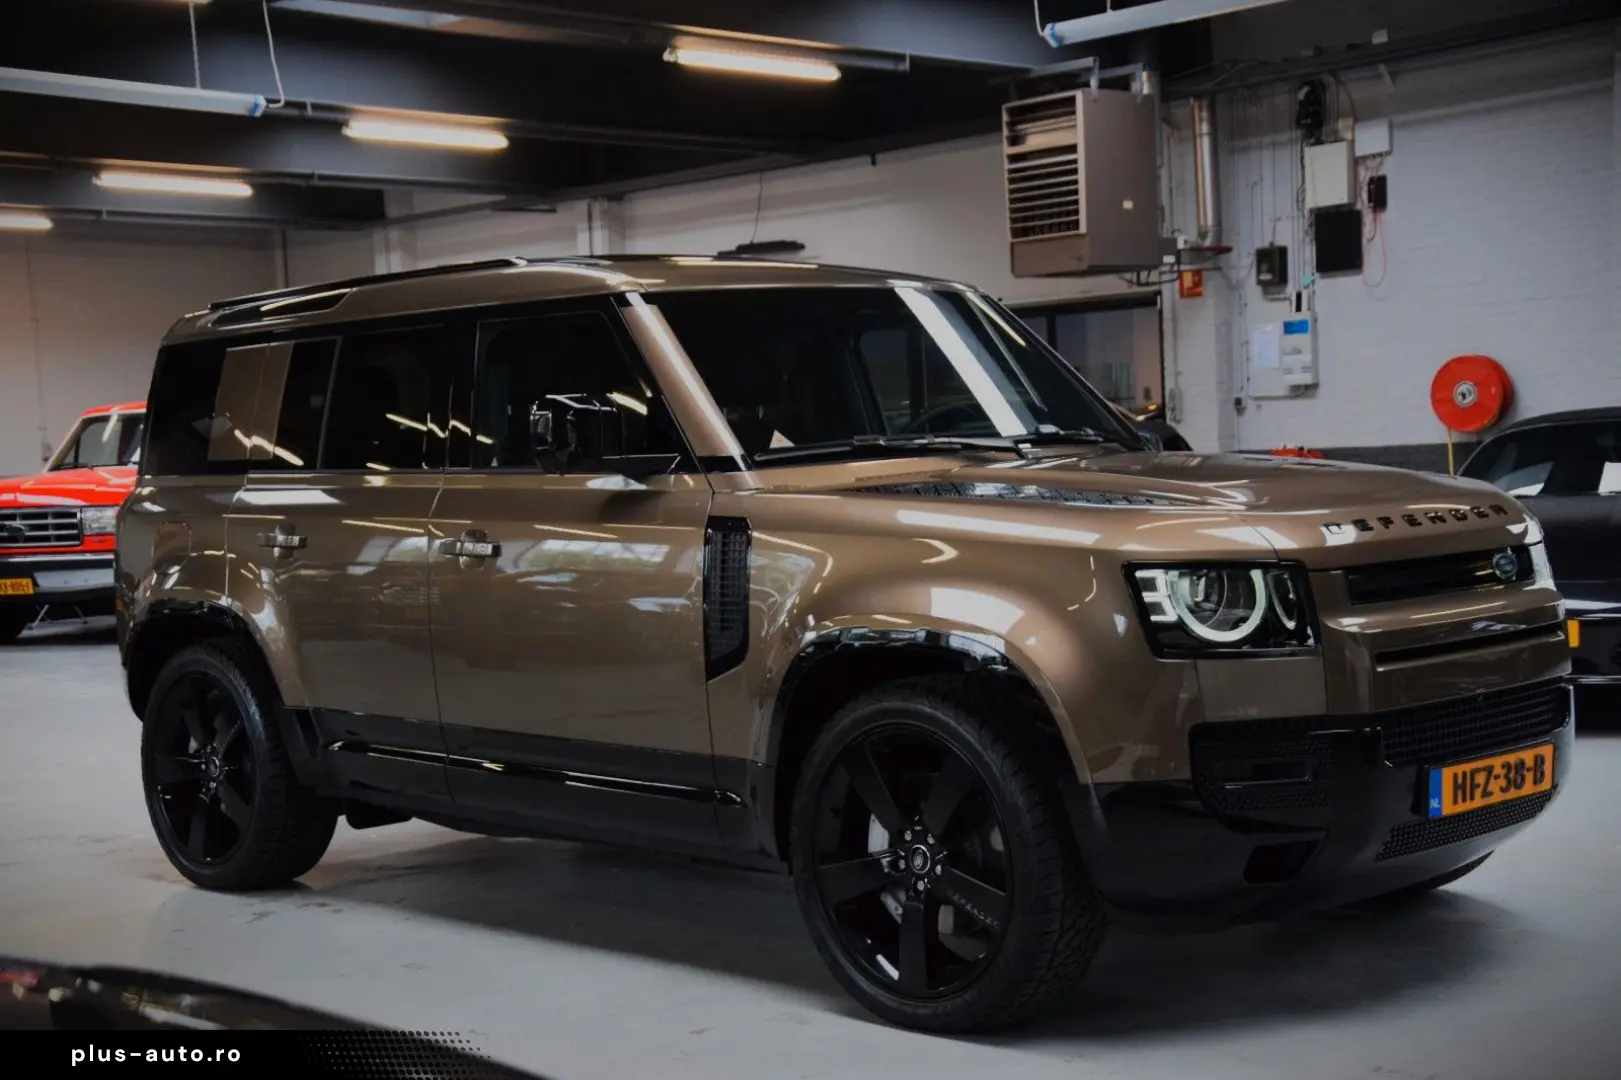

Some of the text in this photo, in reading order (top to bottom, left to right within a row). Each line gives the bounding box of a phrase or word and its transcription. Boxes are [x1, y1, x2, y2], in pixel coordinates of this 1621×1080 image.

[1322, 504, 1508, 535] DEFENDER
[1452, 753, 1546, 806] HFZ-38-B
[1430, 798, 1440, 808] NL
